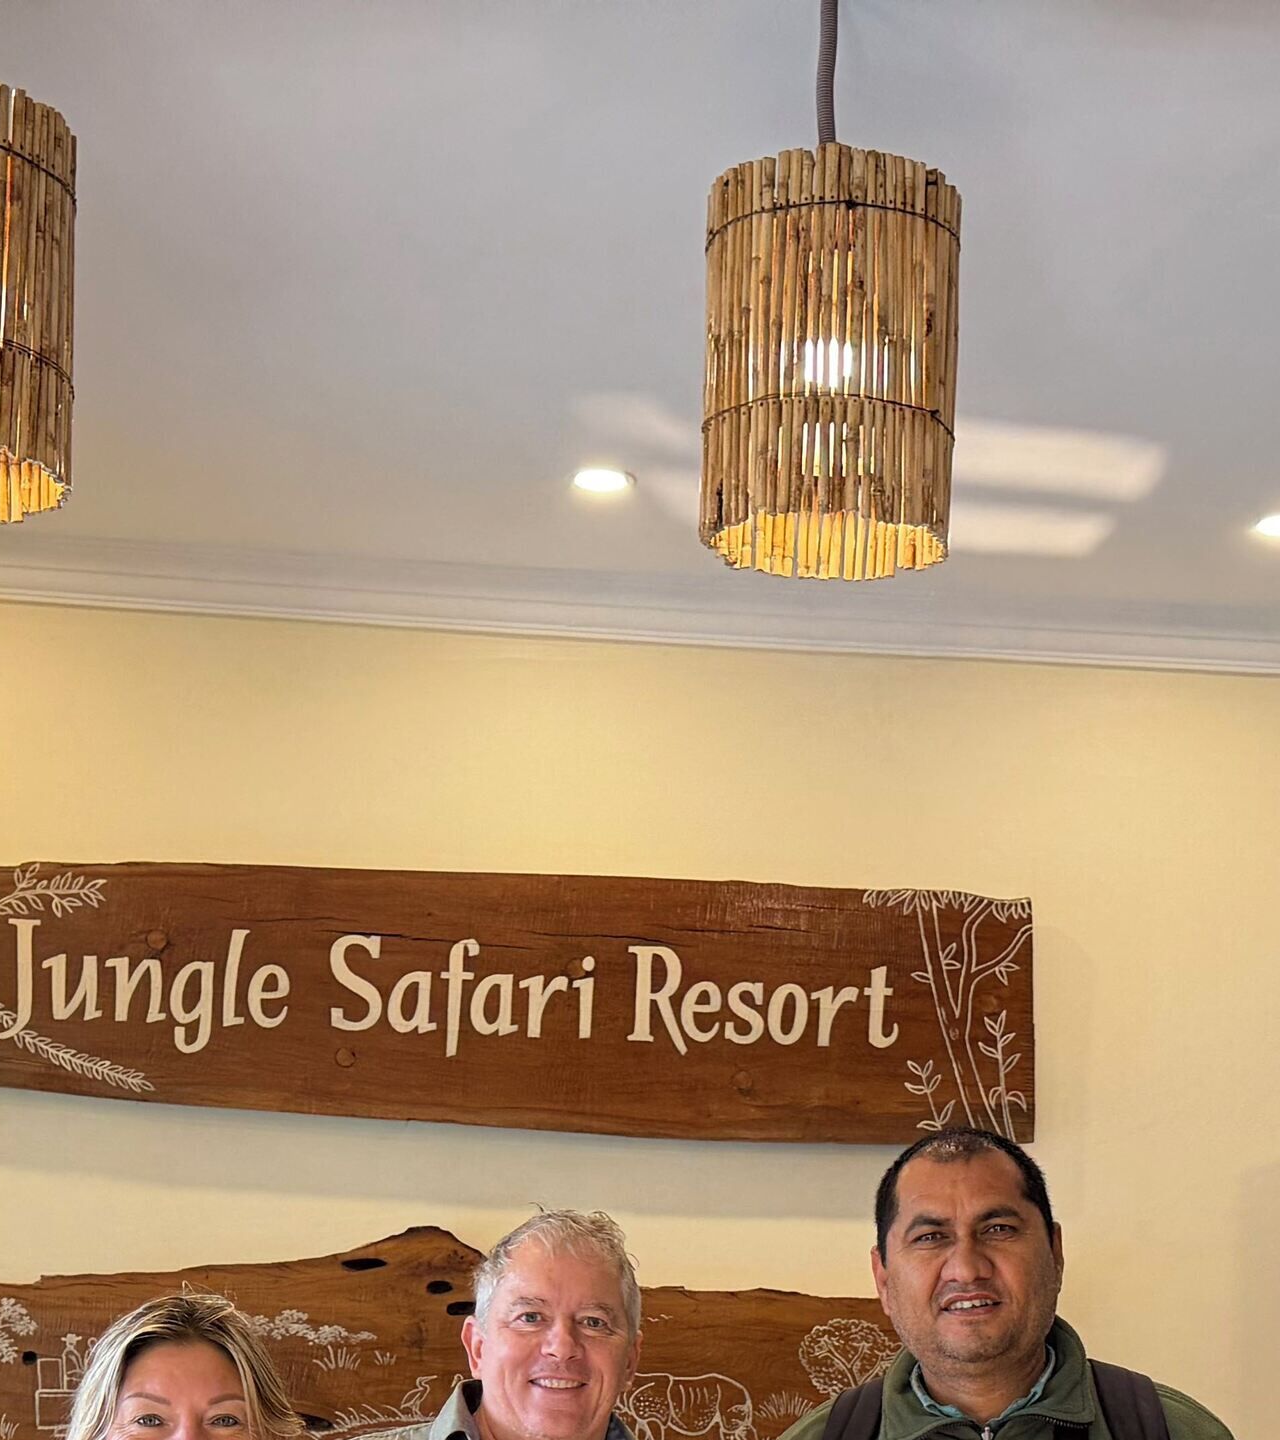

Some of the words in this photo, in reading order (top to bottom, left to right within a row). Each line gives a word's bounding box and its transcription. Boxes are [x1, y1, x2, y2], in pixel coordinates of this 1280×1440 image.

[10, 917, 292, 1054] Jungle
[330, 934, 595, 1058] Safari
[627, 944, 902, 1057] Resort
